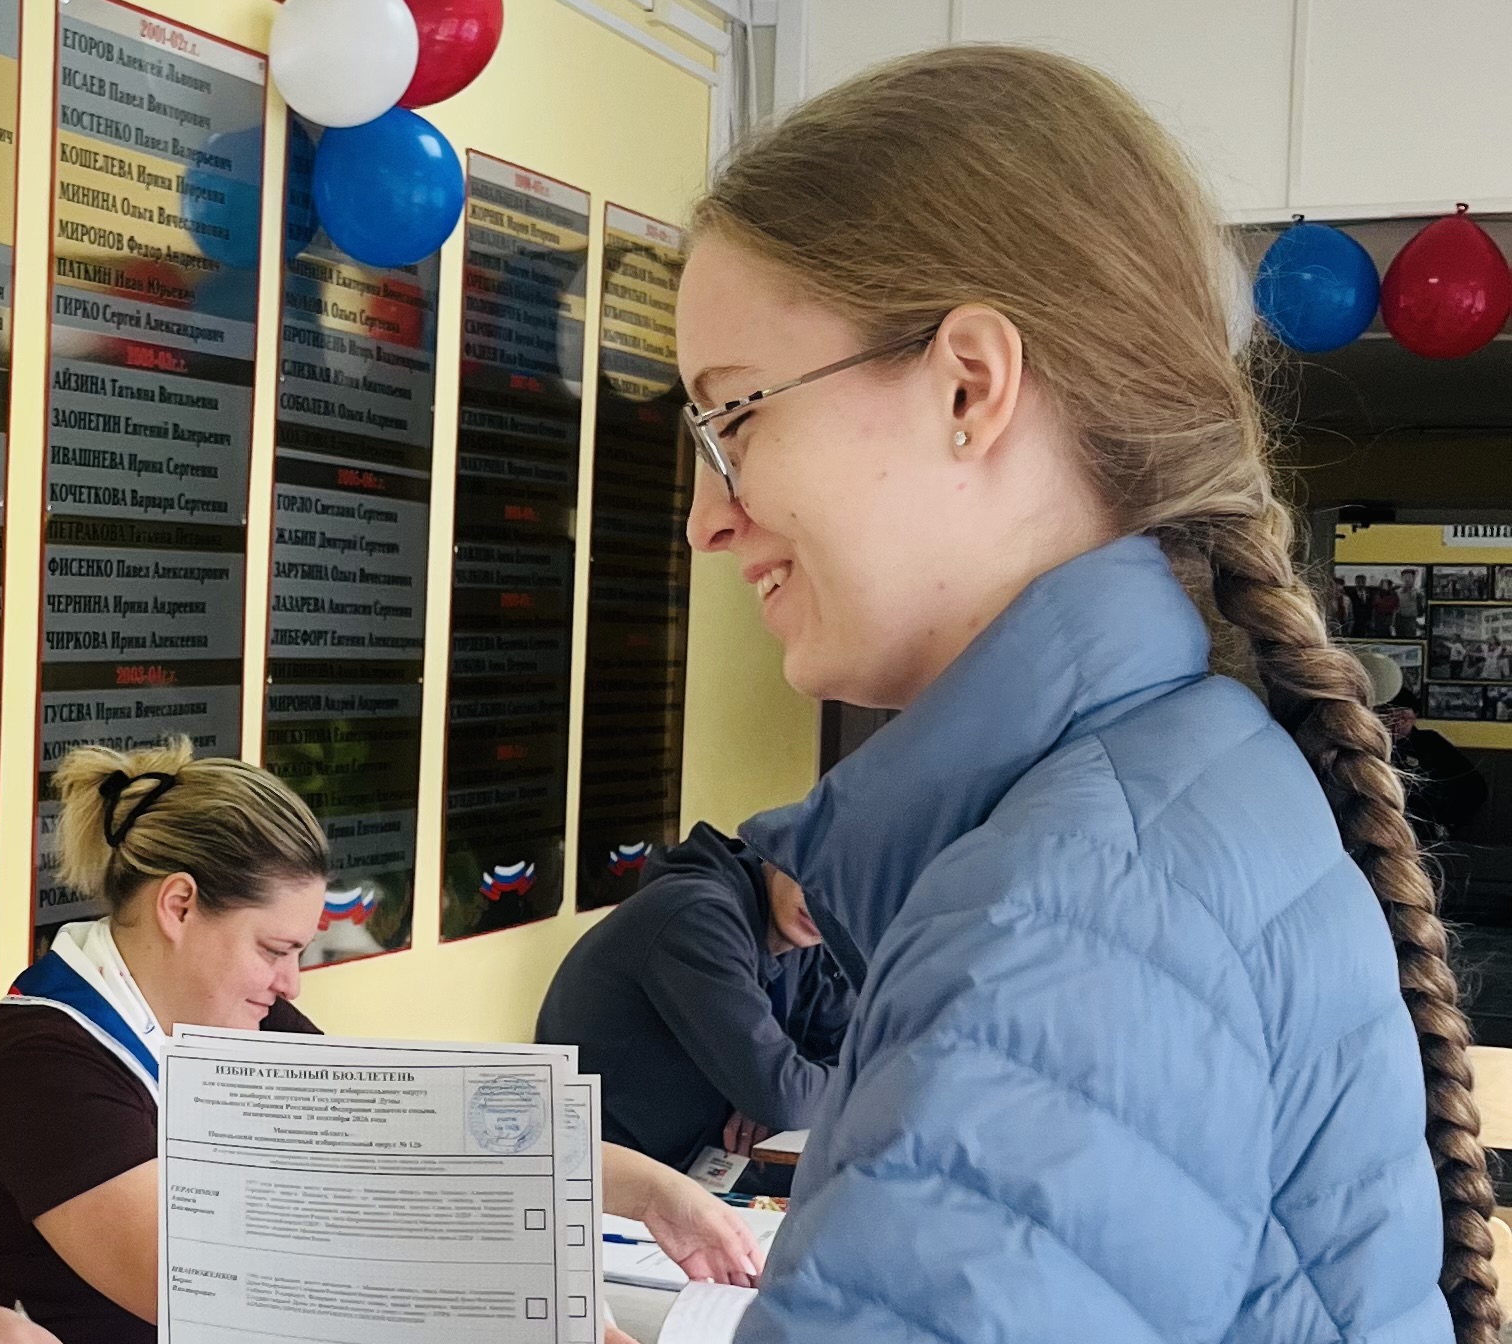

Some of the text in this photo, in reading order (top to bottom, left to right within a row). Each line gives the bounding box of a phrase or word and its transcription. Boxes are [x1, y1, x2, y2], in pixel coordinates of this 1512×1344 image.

[61, 26, 115, 63] ЕГОРОВ
[61, 65, 107, 98] ИСАЕВ
[59, 142, 133, 180] КОШЕЛЕВА
[57, 218, 125, 252] МИРОНОВ
[55, 294, 100, 321] ГИРКО
[46, 556, 114, 577] ФИСЕНКО
[44, 630, 109, 650] ЧИРКОВА
[42, 703, 93, 724] ГУСЕВА
[215, 1065, 415, 1082] ИЗБИРАТЕЛЬНЫЙ БЮЛЛЕТЕНЬ
